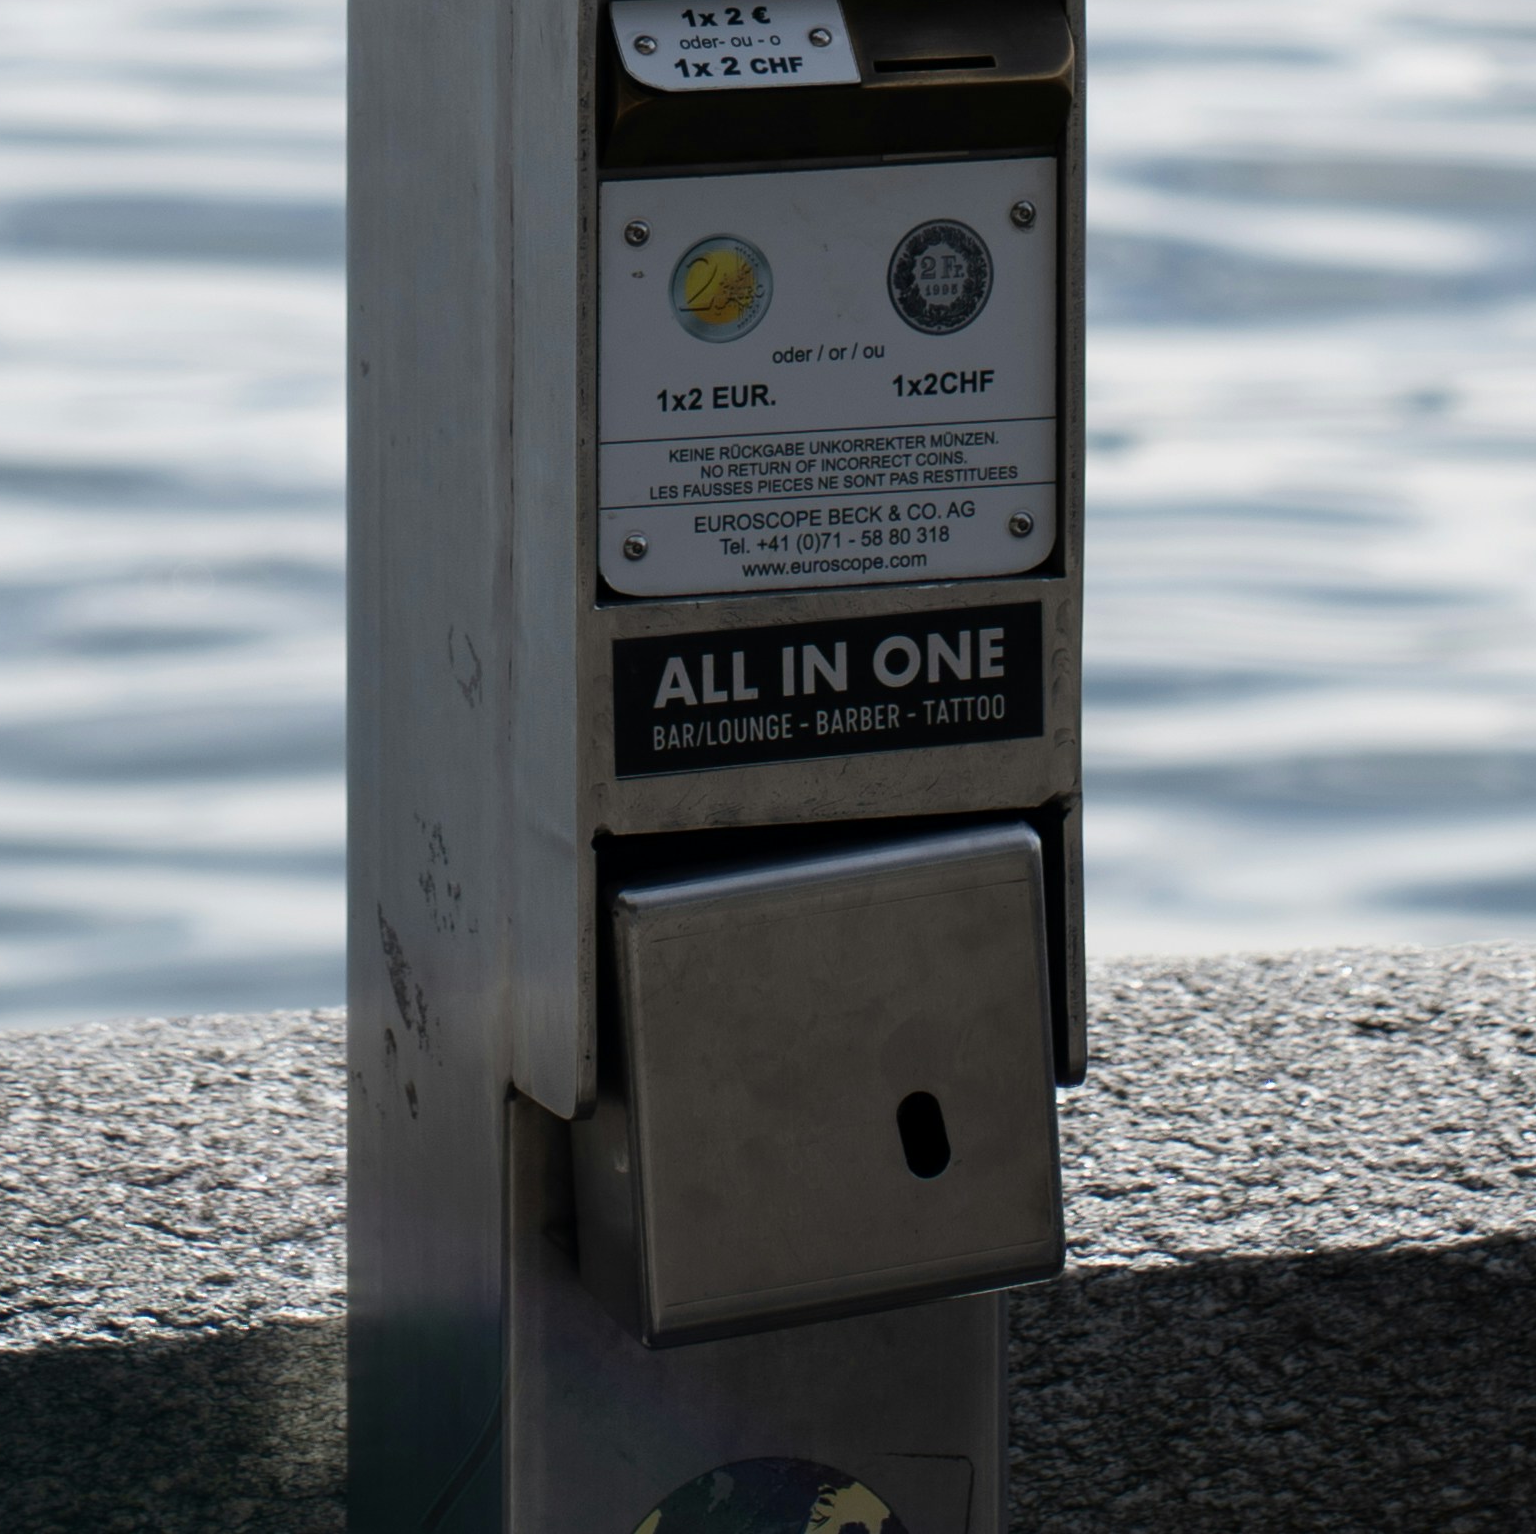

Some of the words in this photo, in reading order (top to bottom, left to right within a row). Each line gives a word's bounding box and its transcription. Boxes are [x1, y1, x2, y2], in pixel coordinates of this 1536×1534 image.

[681, 9, 718, 27] 1x
[724, 7, 744, 25] 2
[751, 6, 770, 24] €
[680, 35, 725, 49] oder-
[731, 36, 753, 47] ou
[770, 35, 781, 46] o
[675, 59, 713, 77] 1x
[721, 57, 741, 75] 2
[750, 57, 802, 74] CHF
[921, 256, 936, 280] 2
[679, 257, 718, 311] 2
[772, 347, 813, 364] oder
[817, 344, 824, 361] /
[829, 347, 847, 360] or
[851, 342, 858, 360] /
[863, 345, 884, 359] ou
[893, 370, 994, 397] 1x2CHF
[657, 388, 702, 412] 1x2
[713, 384, 775, 409] EUR.
[669, 447, 714, 462] KEINE
[720, 442, 804, 460] RÜCKGABE
[809, 435, 926, 454] UNKORREKTER
[931, 431, 998, 447] MÜNZEN.
[701, 465, 723, 478] NO
[728, 461, 791, 477] RETURN
[796, 459, 817, 473] OF
[822, 454, 912, 471] INCORRECT
[916, 451, 967, 466] COINS.
[650, 485, 678, 500] LES
[683, 481, 753, 498] FAUSSES
[758, 477, 813, 493] PIECES
[818, 476, 838, 490] NE
[843, 473, 886, 488] SONT
[890, 471, 919, 485] PAS
[923, 466, 1018, 483] RESTITUEES
[695, 509, 822, 533] EUROSCOPE
[829, 506, 882, 525] BECK
[888, 505, 901, 521] &
[907, 503, 941, 520] CO.
[947, 501, 975, 518] AG
[719, 538, 750, 555] Tel.
[757, 535, 788, 552] +41
[797, 532, 840, 554] (0)71
[861, 529, 883, 547] 58
[889, 528, 911, 545] 80
[917, 525, 949, 543] 318
[742, 554, 927, 577] www.euroscope.com
[654, 651, 758, 708] ALL
[782, 642, 847, 696] IN
[873, 628, 1004, 687] ONE
[654, 714, 793, 750] BAR/LOUNGE
[817, 704, 899, 735] BARBER
[923, 694, 1004, 724] TATTOO
